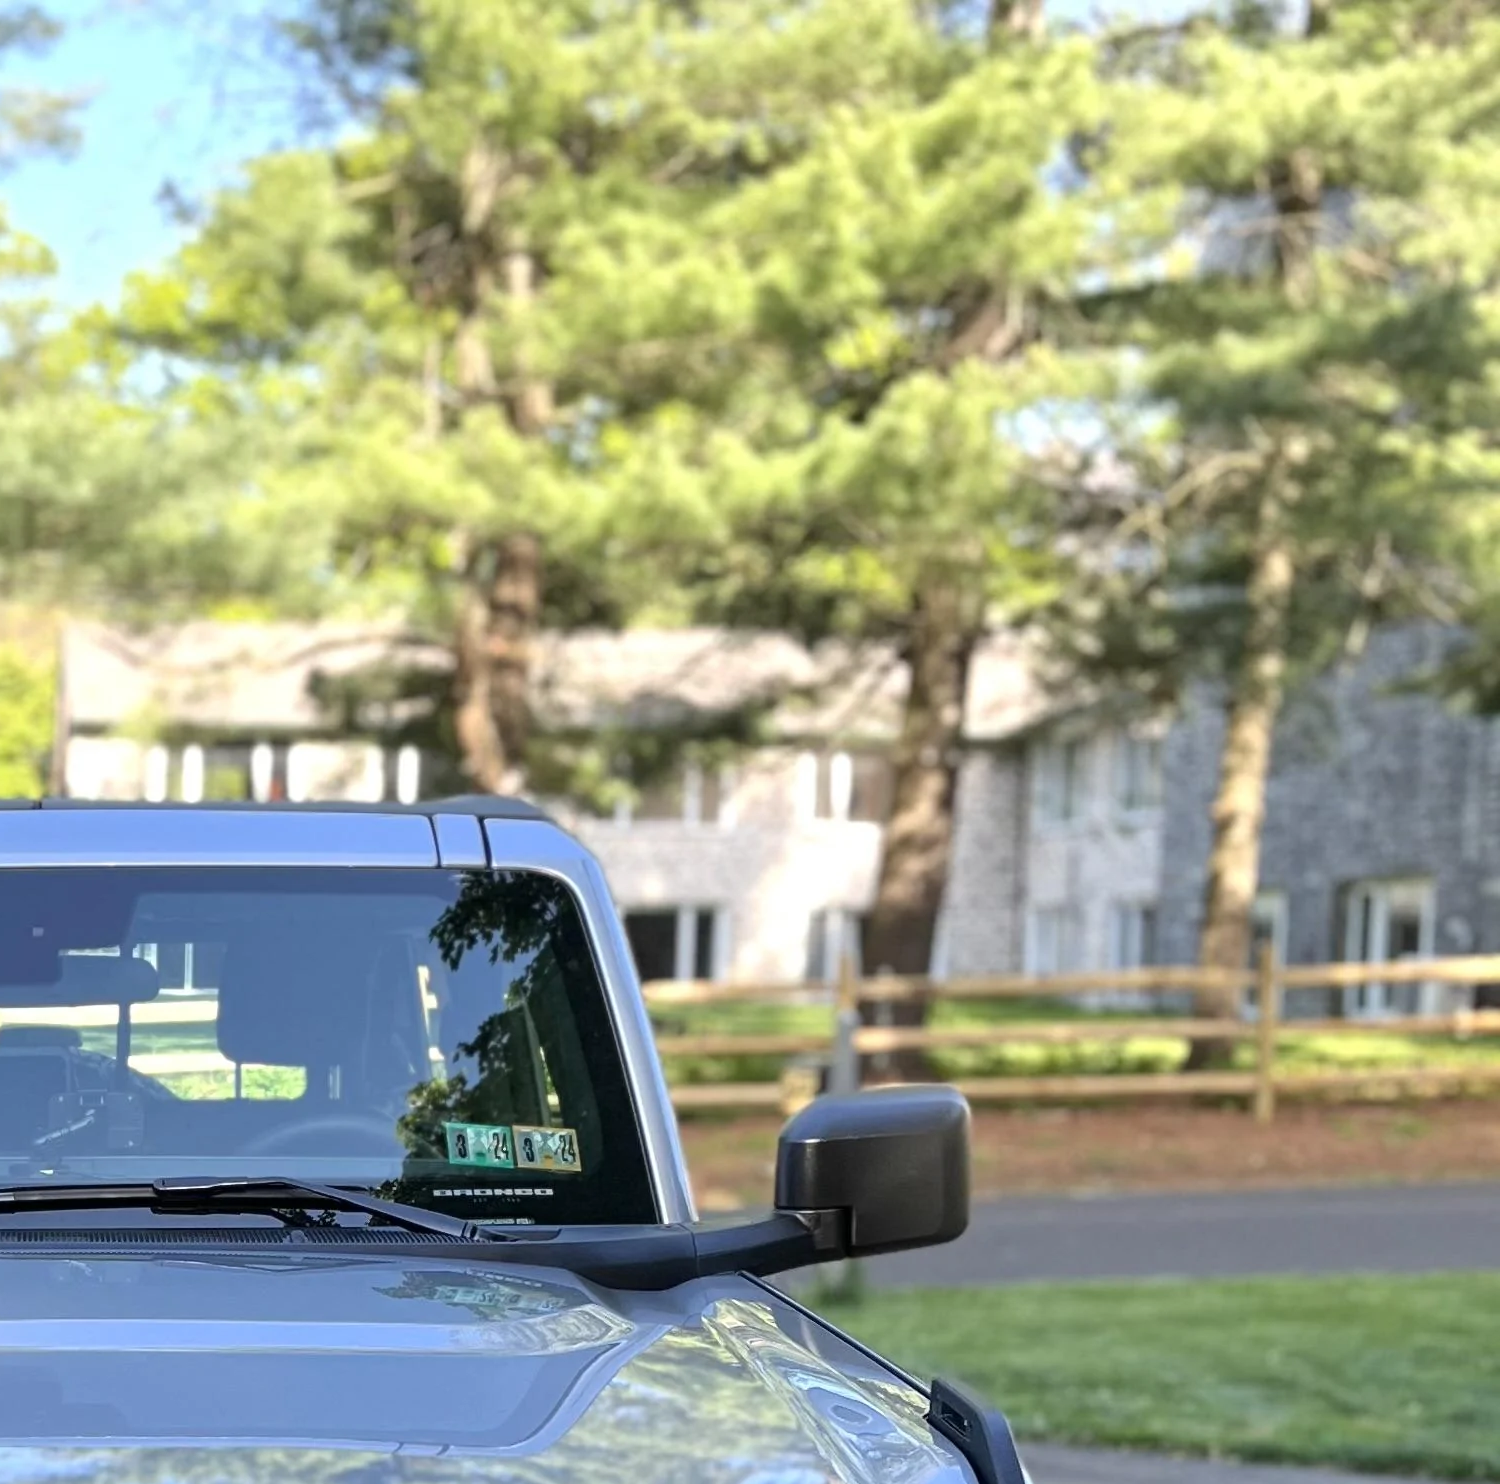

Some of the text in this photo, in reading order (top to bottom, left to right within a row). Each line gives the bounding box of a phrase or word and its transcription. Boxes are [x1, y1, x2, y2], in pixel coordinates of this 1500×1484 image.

[456, 1132, 509, 1160] 3 24
[523, 1134, 577, 1162] 3 24
[432, 1188, 554, 1197] BRONCO
